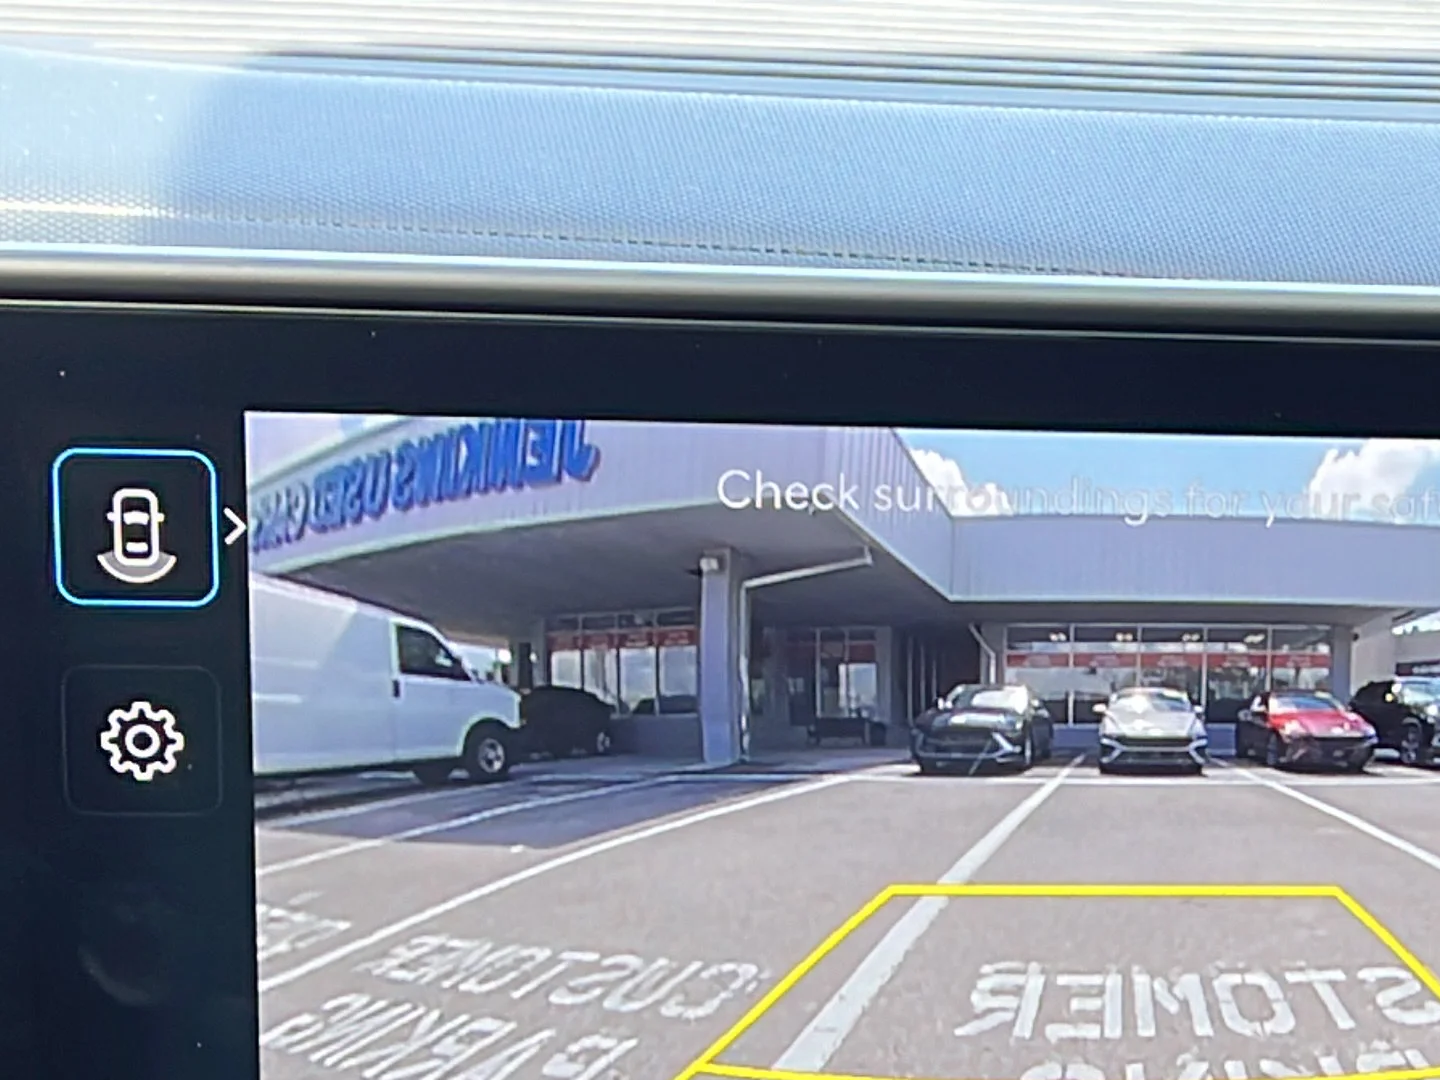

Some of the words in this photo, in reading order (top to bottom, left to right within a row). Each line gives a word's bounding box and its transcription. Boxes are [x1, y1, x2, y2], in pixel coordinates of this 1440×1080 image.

[716, 469, 861, 512] Check
[874, 476, 1170, 526] surroundings
[1183, 480, 1248, 518] for
[1261, 488, 1363, 528] your
